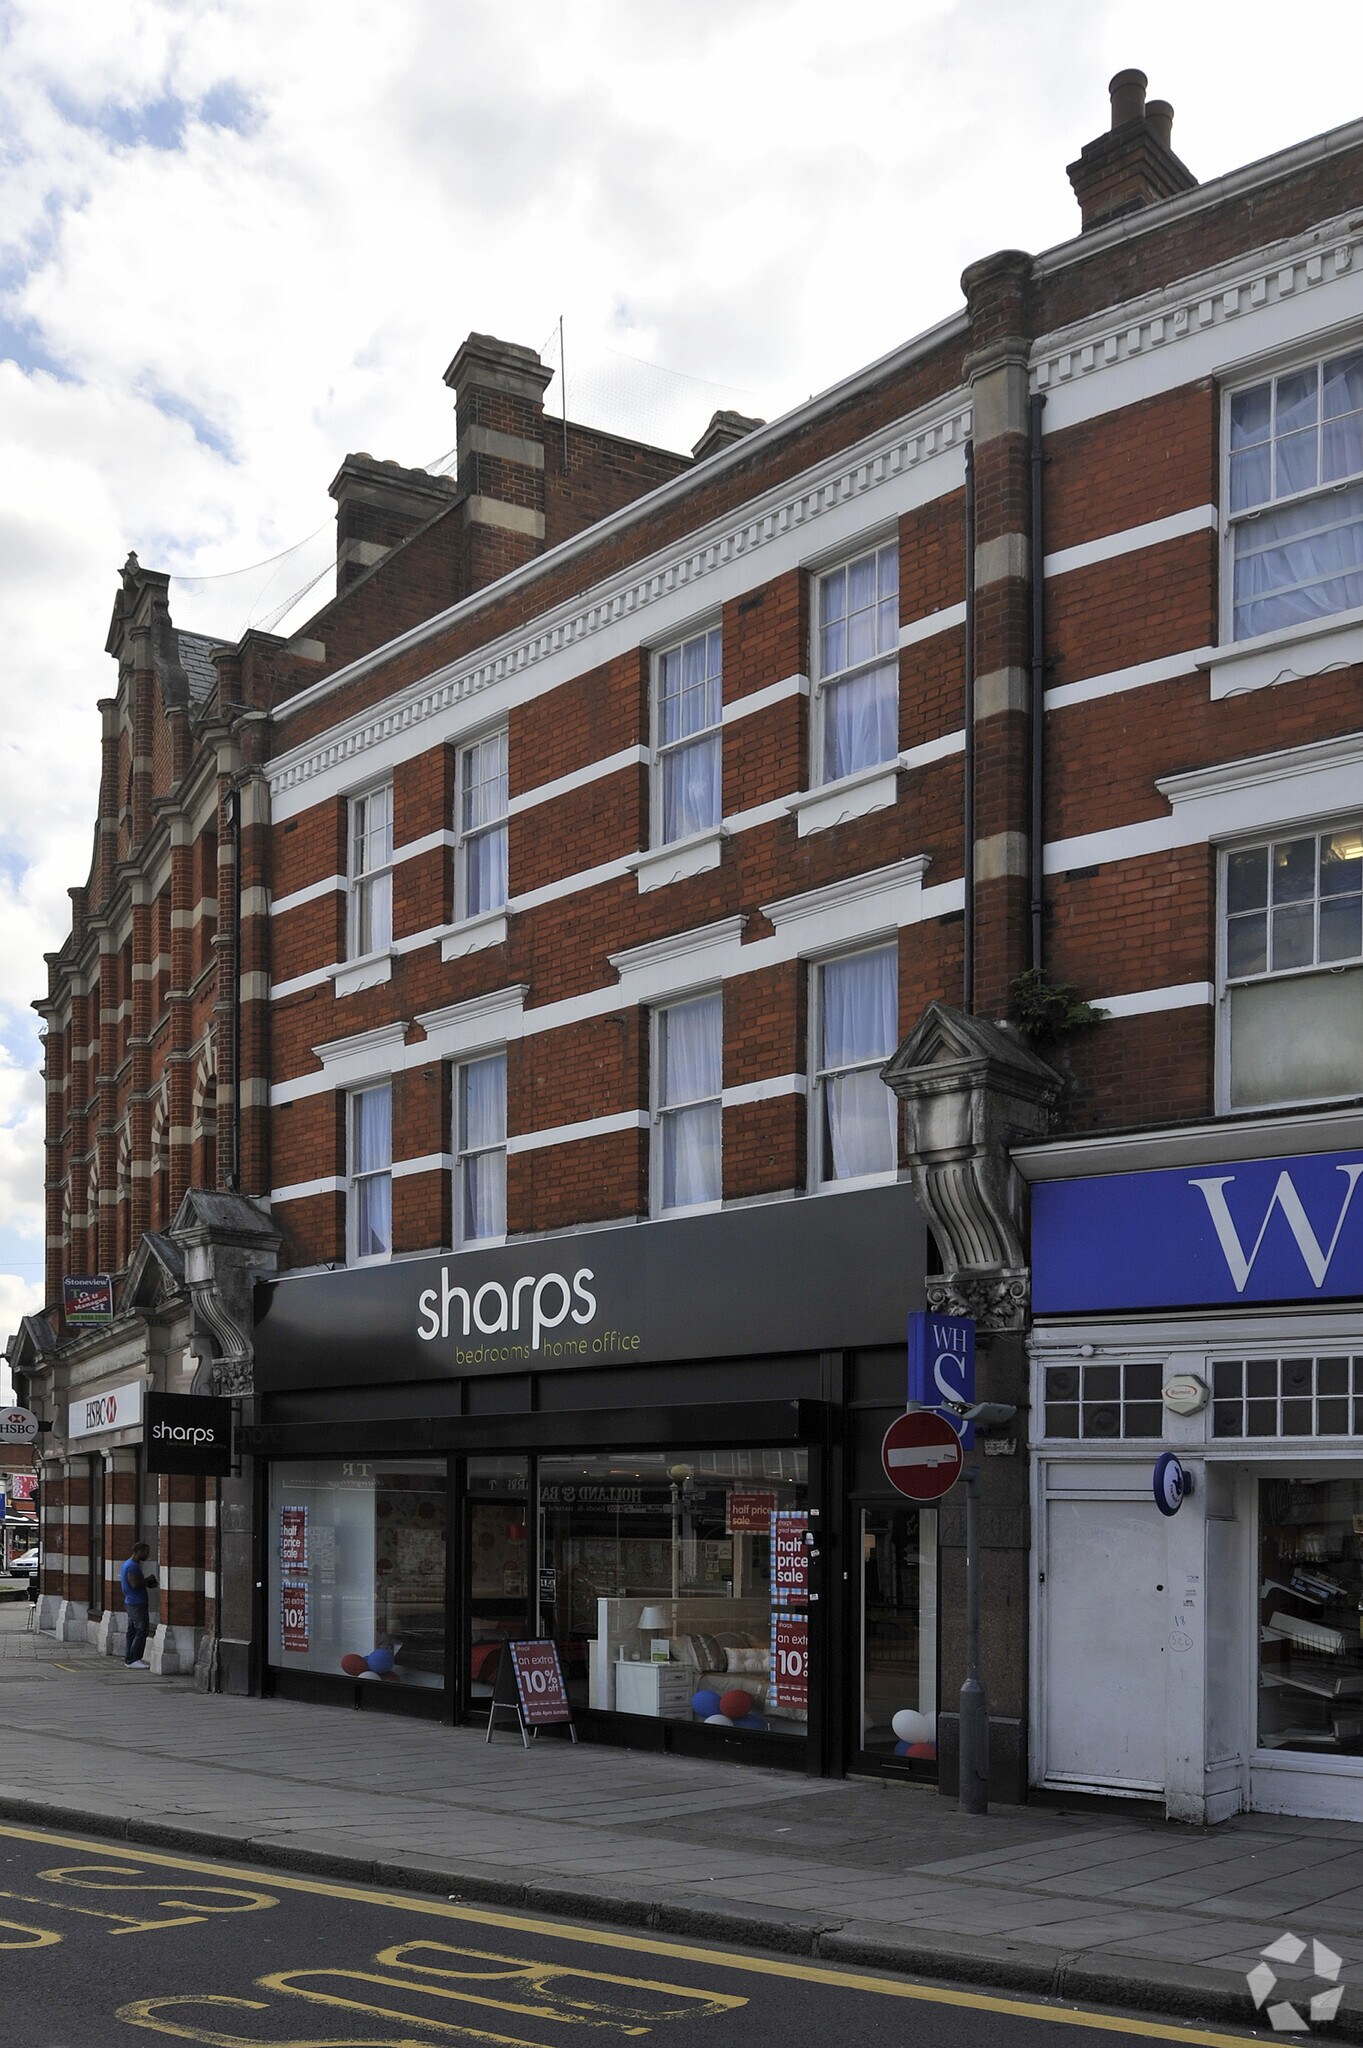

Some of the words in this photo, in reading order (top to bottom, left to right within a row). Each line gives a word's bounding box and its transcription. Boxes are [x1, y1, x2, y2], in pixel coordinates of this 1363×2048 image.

[1188, 1164, 1363, 1292] W
[64, 1278, 107, 1286] Stoneview
[417, 1266, 597, 1350] sharps
[932, 1324, 968, 1353] WH
[455, 1344, 530, 1365] bedrooms
[543, 1337, 587, 1357] home
[592, 1331, 641, 1353] office
[86, 1398, 107, 1429] HSBC
[0, 1424, 35, 1434] HSBC
[152, 1420, 215, 1446] sharps
[732, 1504, 750, 1515] half
[751, 1505, 773, 1516] price
[732, 1516, 751, 1525] sale
[283, 1525, 298, 1536] half
[283, 1536, 301, 1549] price
[777, 1537, 803, 1552] half
[283, 1547, 298, 1559] sale
[777, 1552, 809, 1570] price
[777, 1567, 804, 1583] sale
[284, 1608, 305, 1628] 10%
[777, 1634, 790, 1644] an
[791, 1635, 808, 1645] extr
[518, 1657, 530, 1665] an
[531, 1655, 554, 1665] extra
[521, 1669, 558, 1694] 10%
[547, 1684, 560, 1693] off
